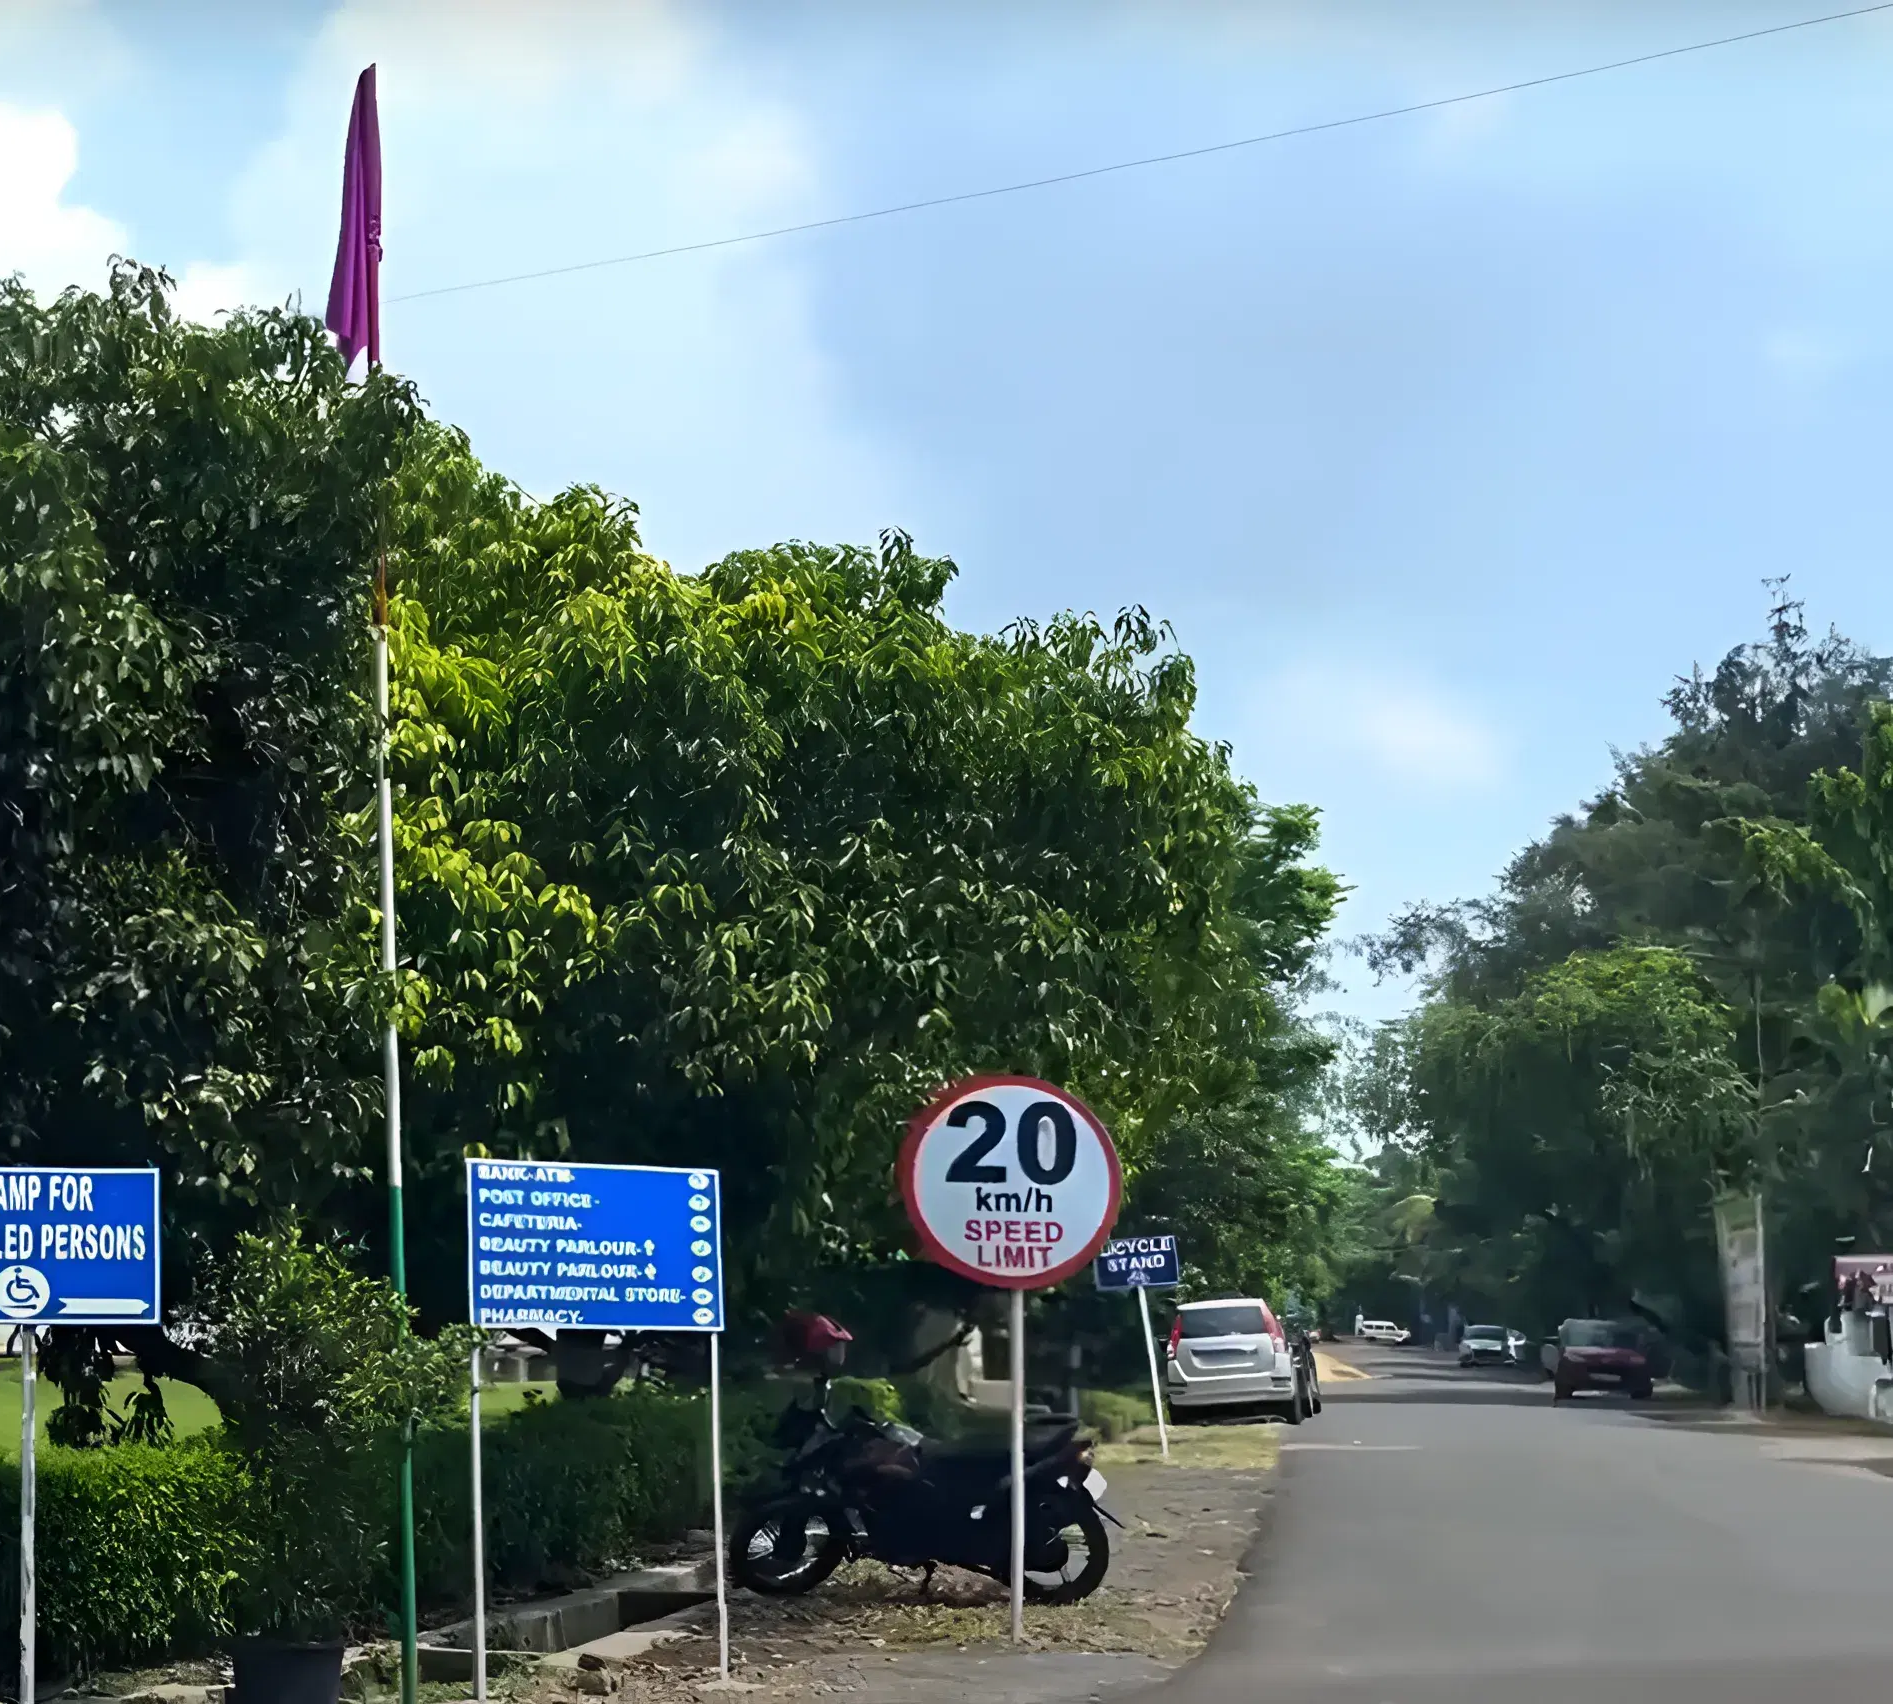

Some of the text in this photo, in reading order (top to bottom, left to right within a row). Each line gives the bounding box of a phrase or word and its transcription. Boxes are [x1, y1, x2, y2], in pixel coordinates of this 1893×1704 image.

[946, 1100, 1077, 1185] 20
[49, 1175, 94, 1212] FOR
[478, 1188, 524, 1205] POST
[976, 1186, 1053, 1213] km/h
[40, 1223, 146, 1260] PERSONS
[964, 1220, 1063, 1244] SPEED
[479, 1236, 551, 1253] BEAUTY
[977, 1244, 1053, 1269] LIMIT
[1100, 1238, 1171, 1257] ICYCLE
[479, 1260, 551, 1277] BEAUTY
[1107, 1254, 1165, 1272] STAND
